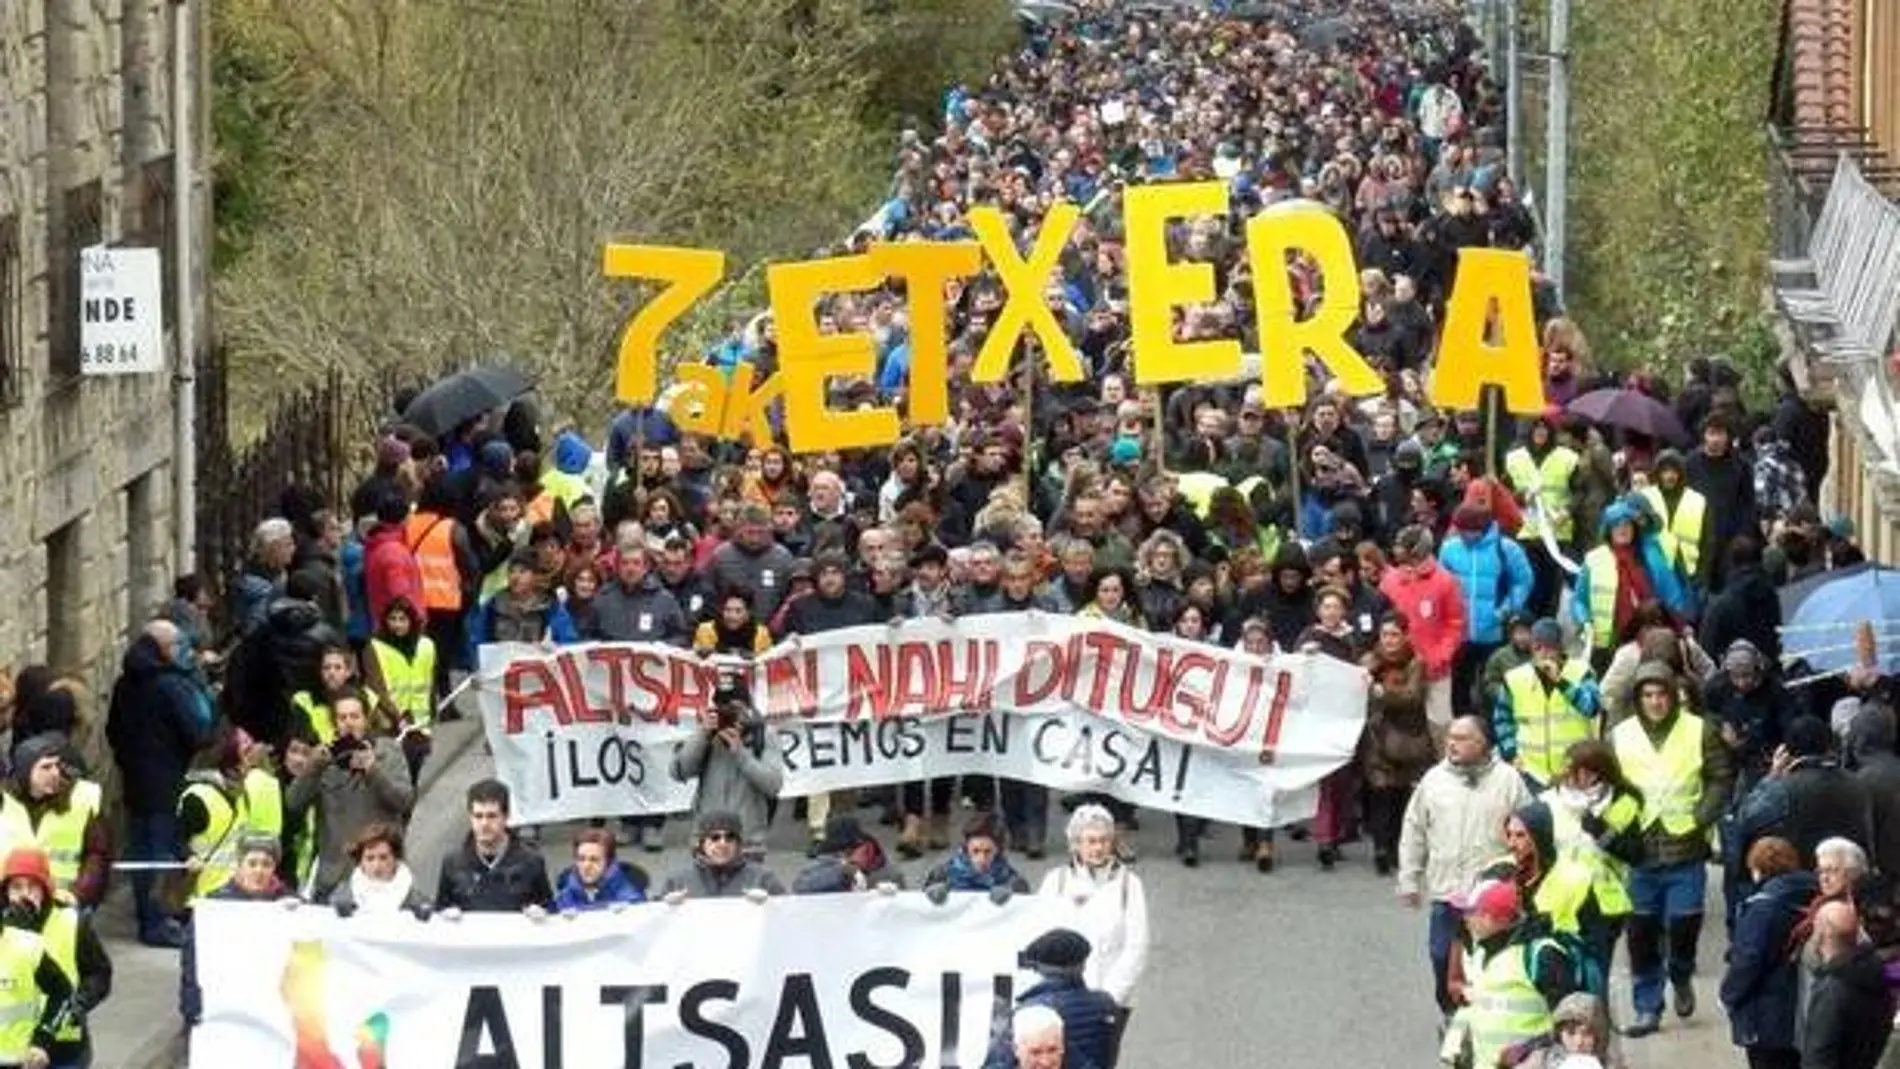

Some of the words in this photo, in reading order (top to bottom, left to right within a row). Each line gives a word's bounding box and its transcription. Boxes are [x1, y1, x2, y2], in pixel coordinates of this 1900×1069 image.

[86, 297, 135, 323] NDE
[767, 180, 1547, 454] ETXERA
[504, 647, 818, 734] ALTSAN
[846, 638, 1000, 720] NAHI
[1014, 631, 1291, 765] DITUGU!
[946, 712, 1010, 754] EN
[1033, 717, 1191, 801] CASA!
